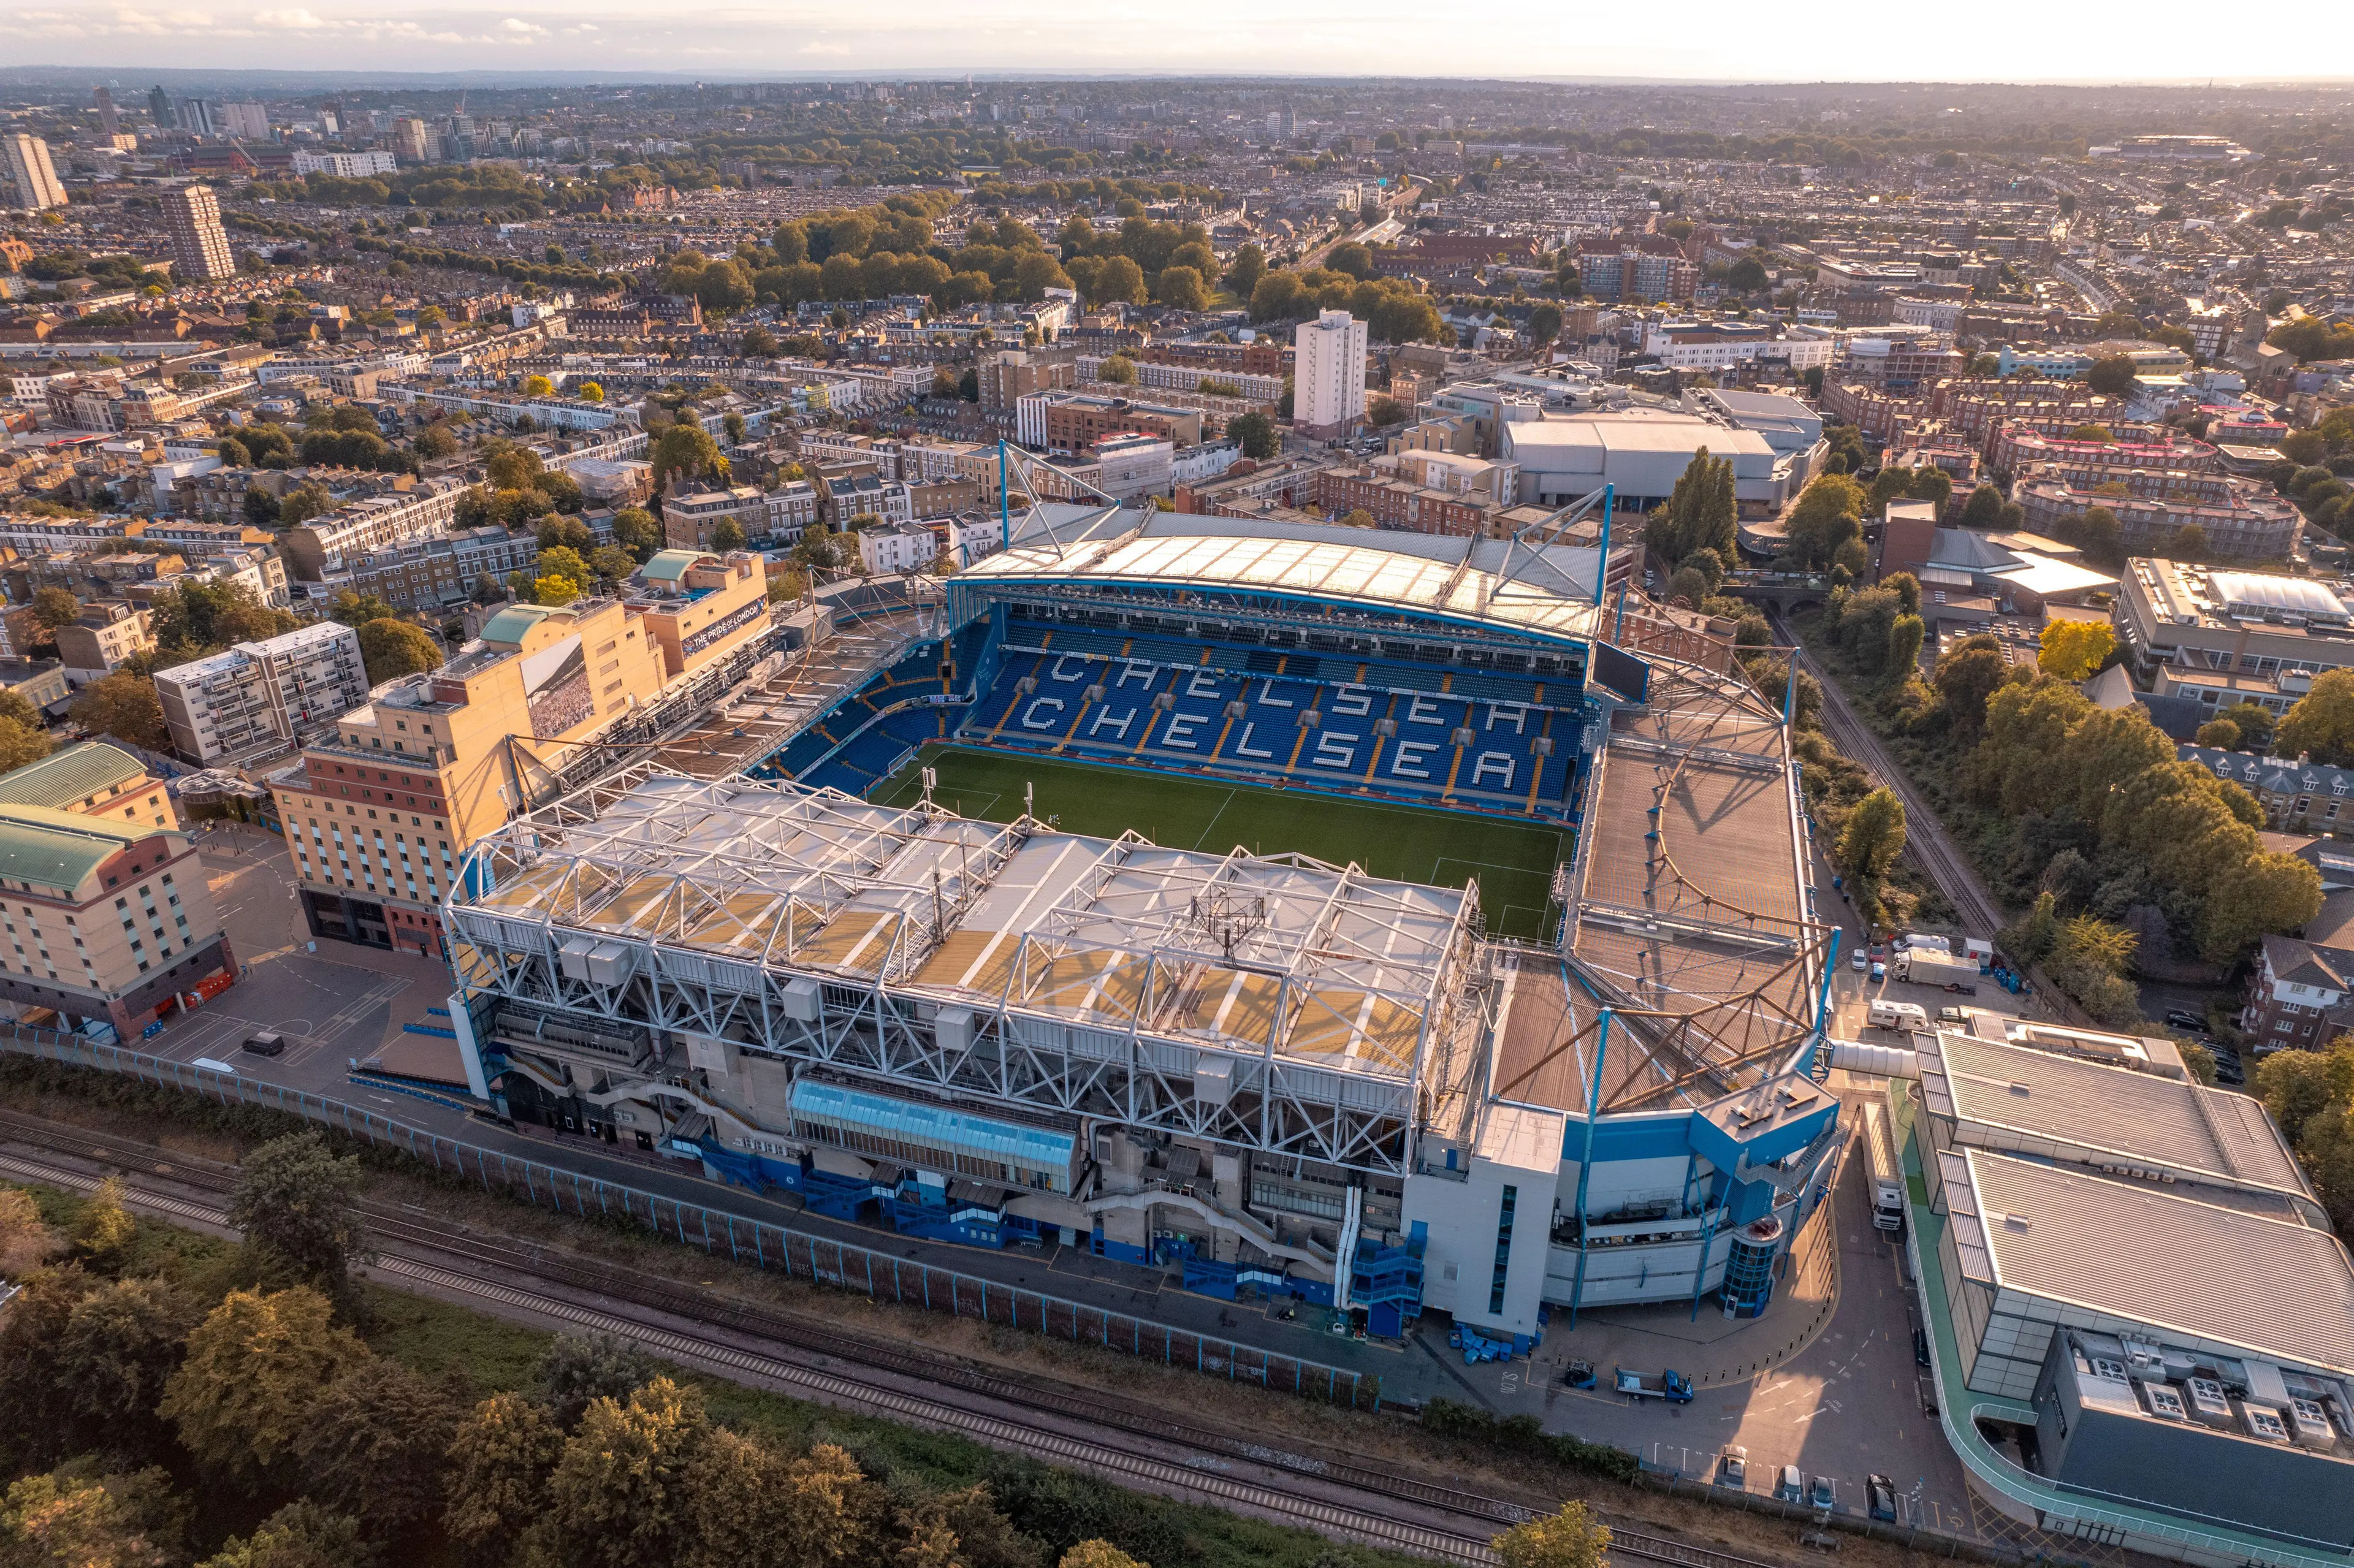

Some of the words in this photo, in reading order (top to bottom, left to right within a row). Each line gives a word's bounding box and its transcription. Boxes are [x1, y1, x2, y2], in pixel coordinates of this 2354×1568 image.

[694, 634, 707, 647] THE
[707, 623, 726, 640] PRIDE
[734, 604, 758, 625] LONDON
[1023, 697, 1515, 789] CHELSEA
